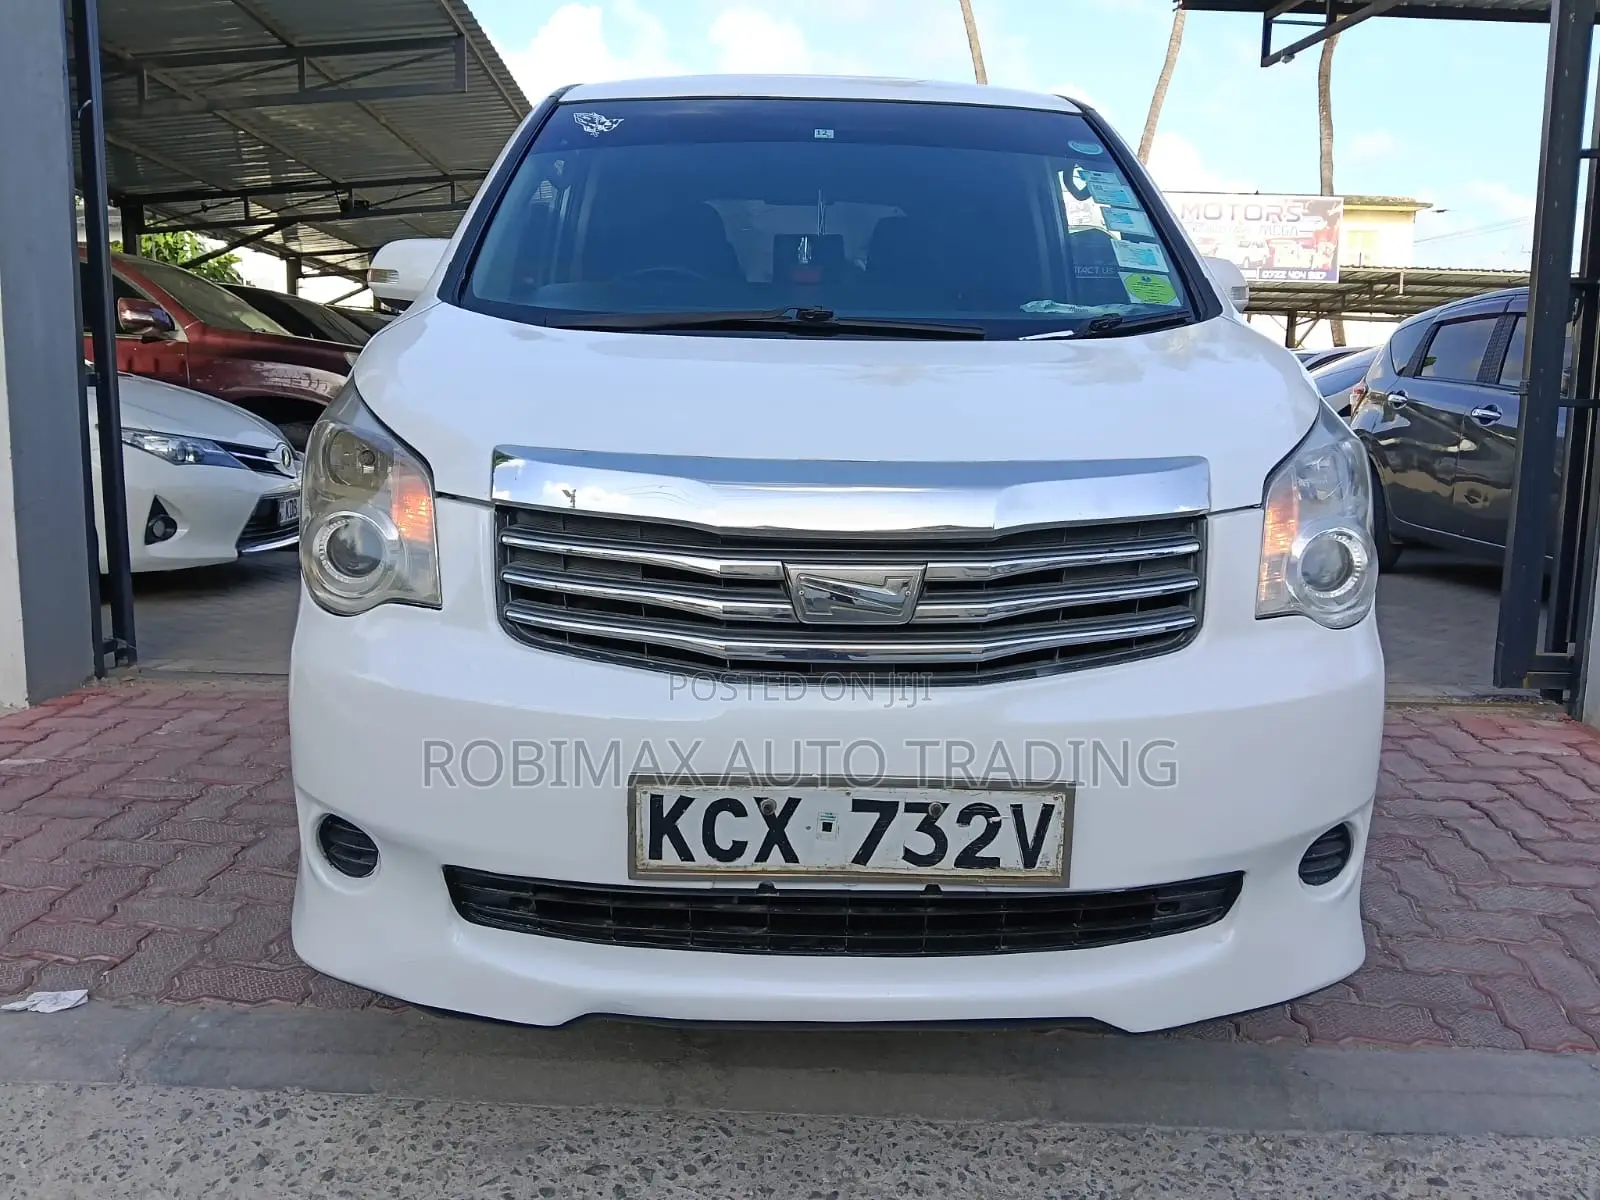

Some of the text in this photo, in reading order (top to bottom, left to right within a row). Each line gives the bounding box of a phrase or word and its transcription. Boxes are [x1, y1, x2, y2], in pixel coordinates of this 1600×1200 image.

[1181, 203, 1301, 222] MOTORS
[648, 793, 1055, 869] KCX 732V
